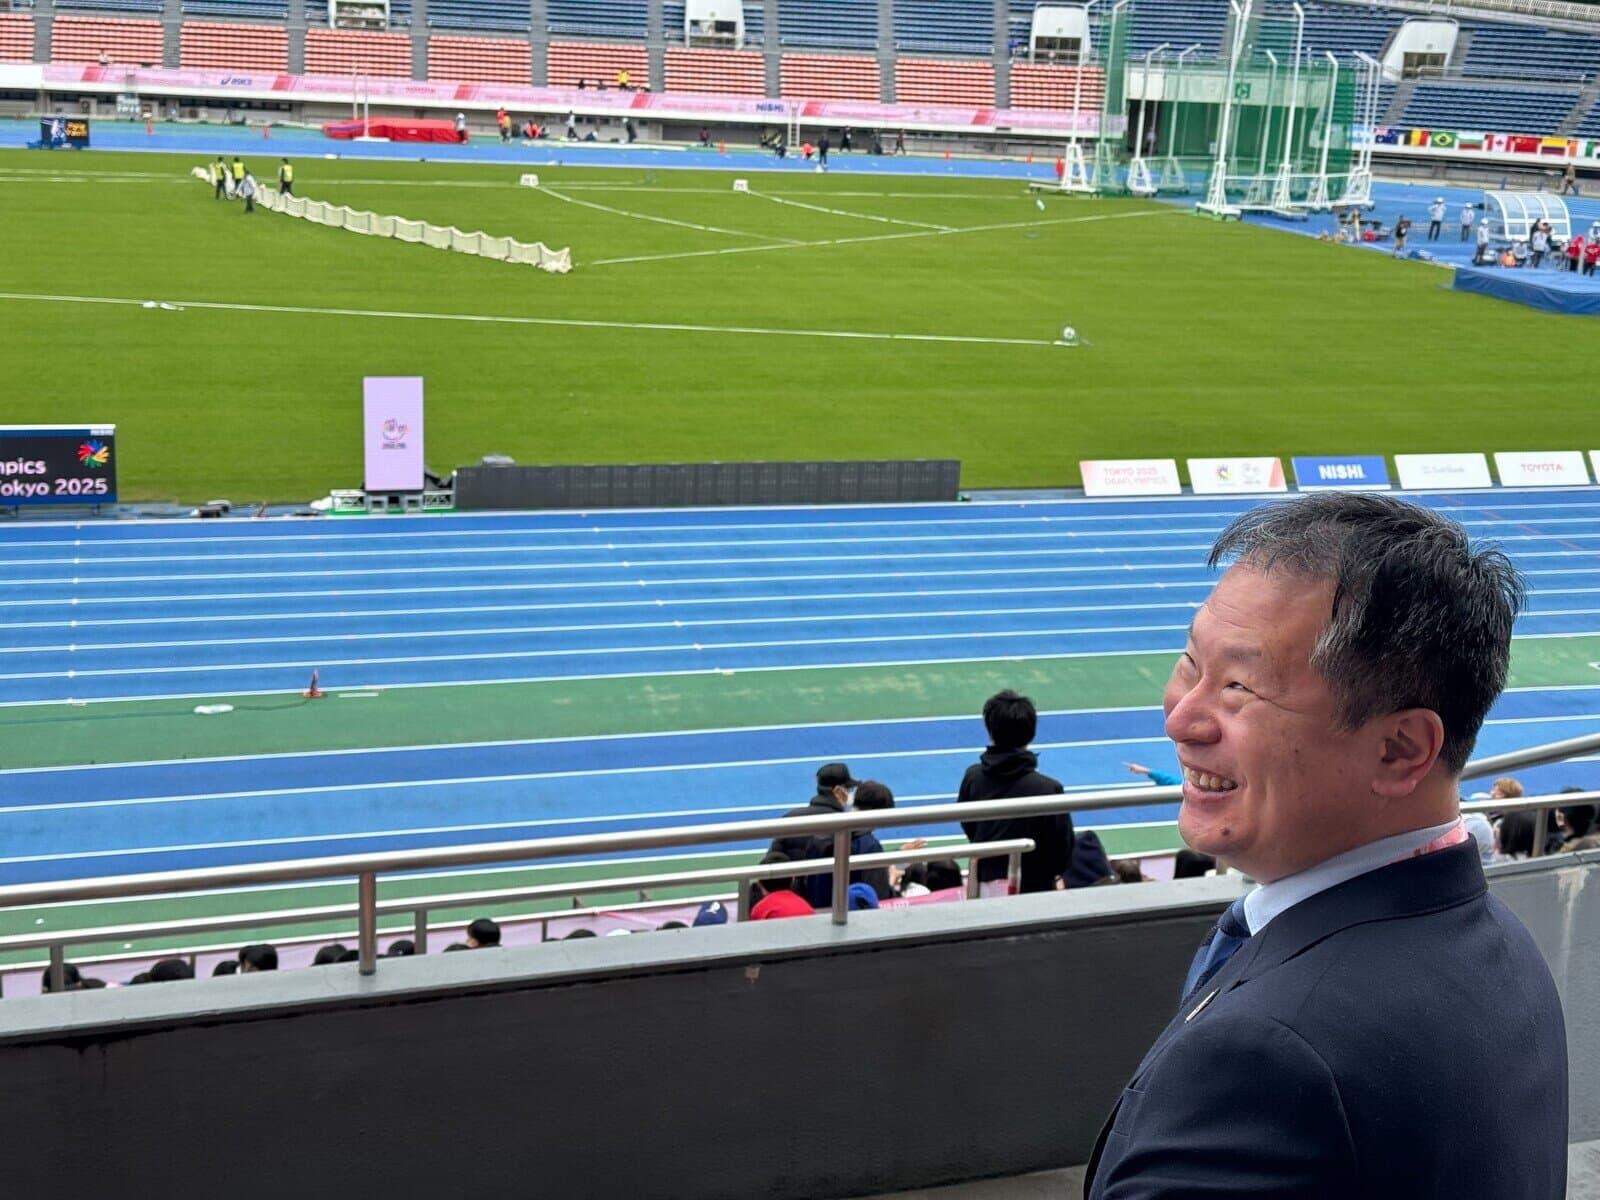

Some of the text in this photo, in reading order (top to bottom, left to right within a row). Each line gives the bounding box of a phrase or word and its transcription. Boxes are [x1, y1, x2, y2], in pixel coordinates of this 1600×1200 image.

[1318, 463, 1364, 480] NISHI
[1521, 464, 1563, 472] TOYOTA
[0, 478, 108, 497] okyo 2025
